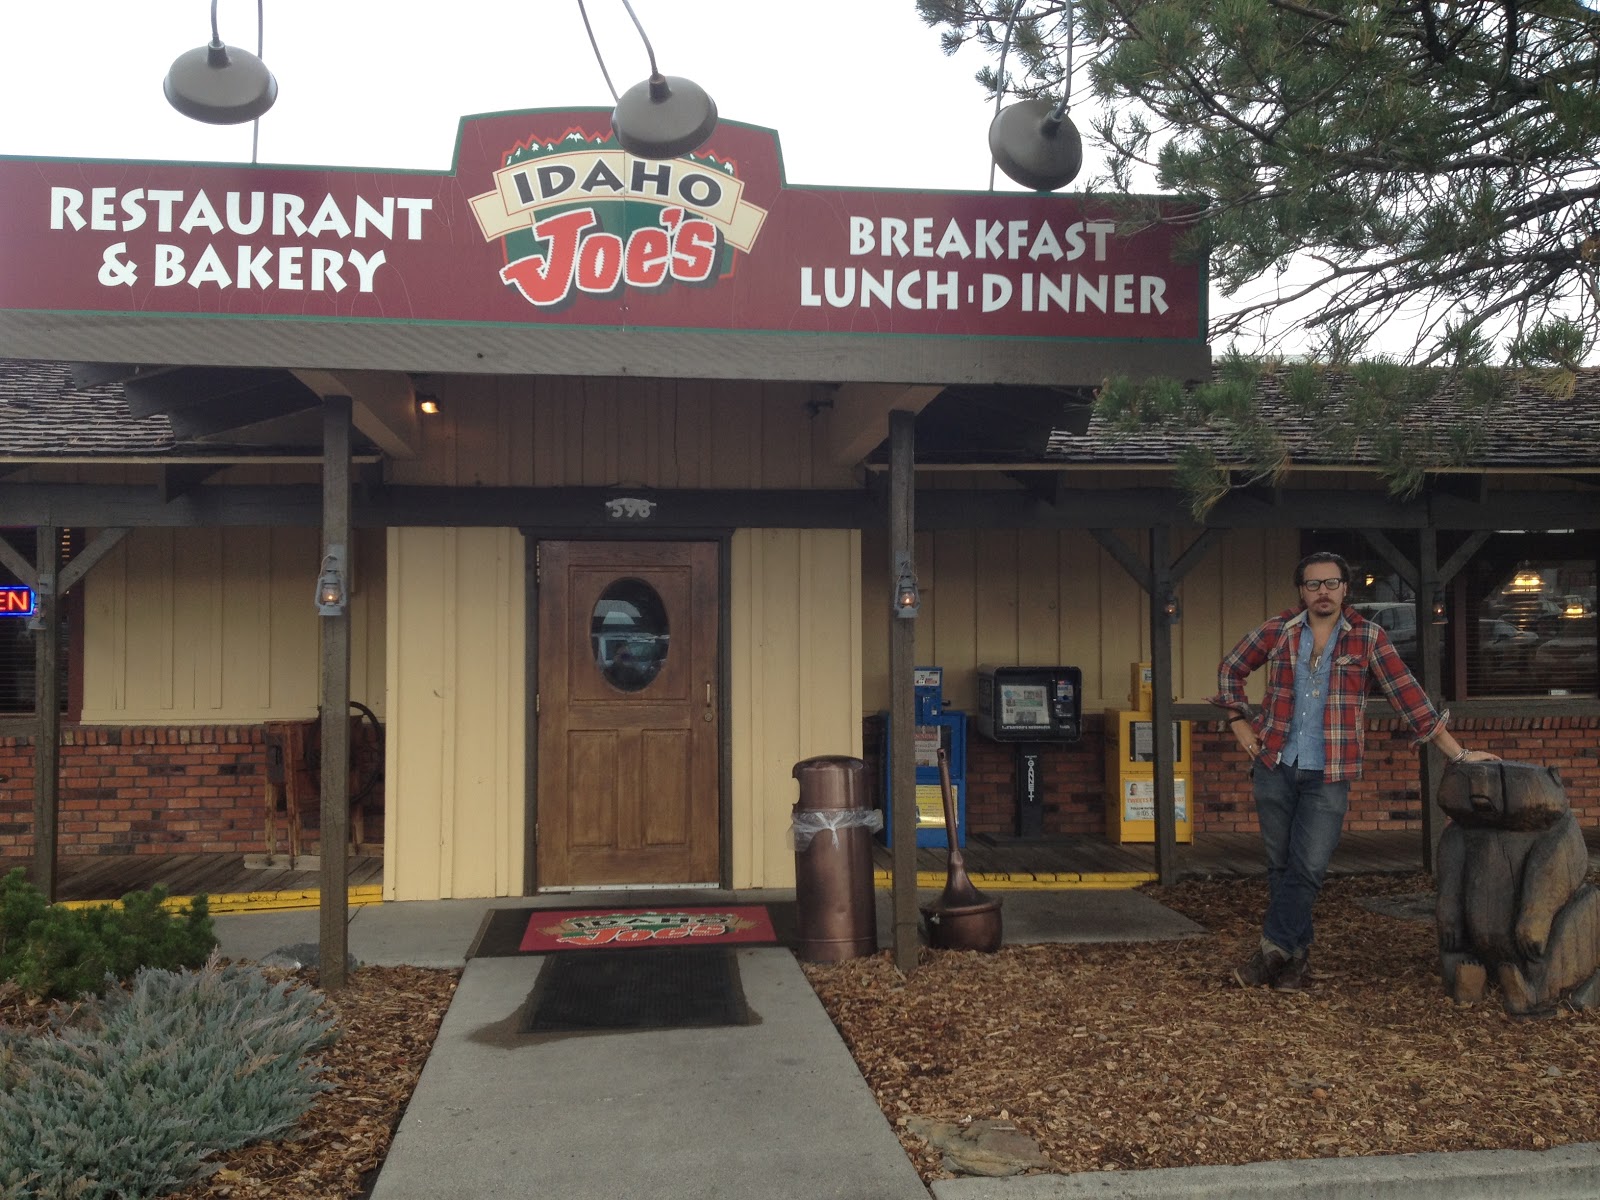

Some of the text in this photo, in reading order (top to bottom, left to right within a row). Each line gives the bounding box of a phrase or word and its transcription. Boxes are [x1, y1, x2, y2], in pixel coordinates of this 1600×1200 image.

[513, 158, 722, 208] IDAHO
[49, 186, 433, 241] RESTAURANT
[849, 216, 1116, 262] BREAKFAST
[97, 242, 387, 293] & BAKERY
[800, 267, 1170, 315] LUNCH DINNER
[1027, 760, 1035, 802] GANNETT
